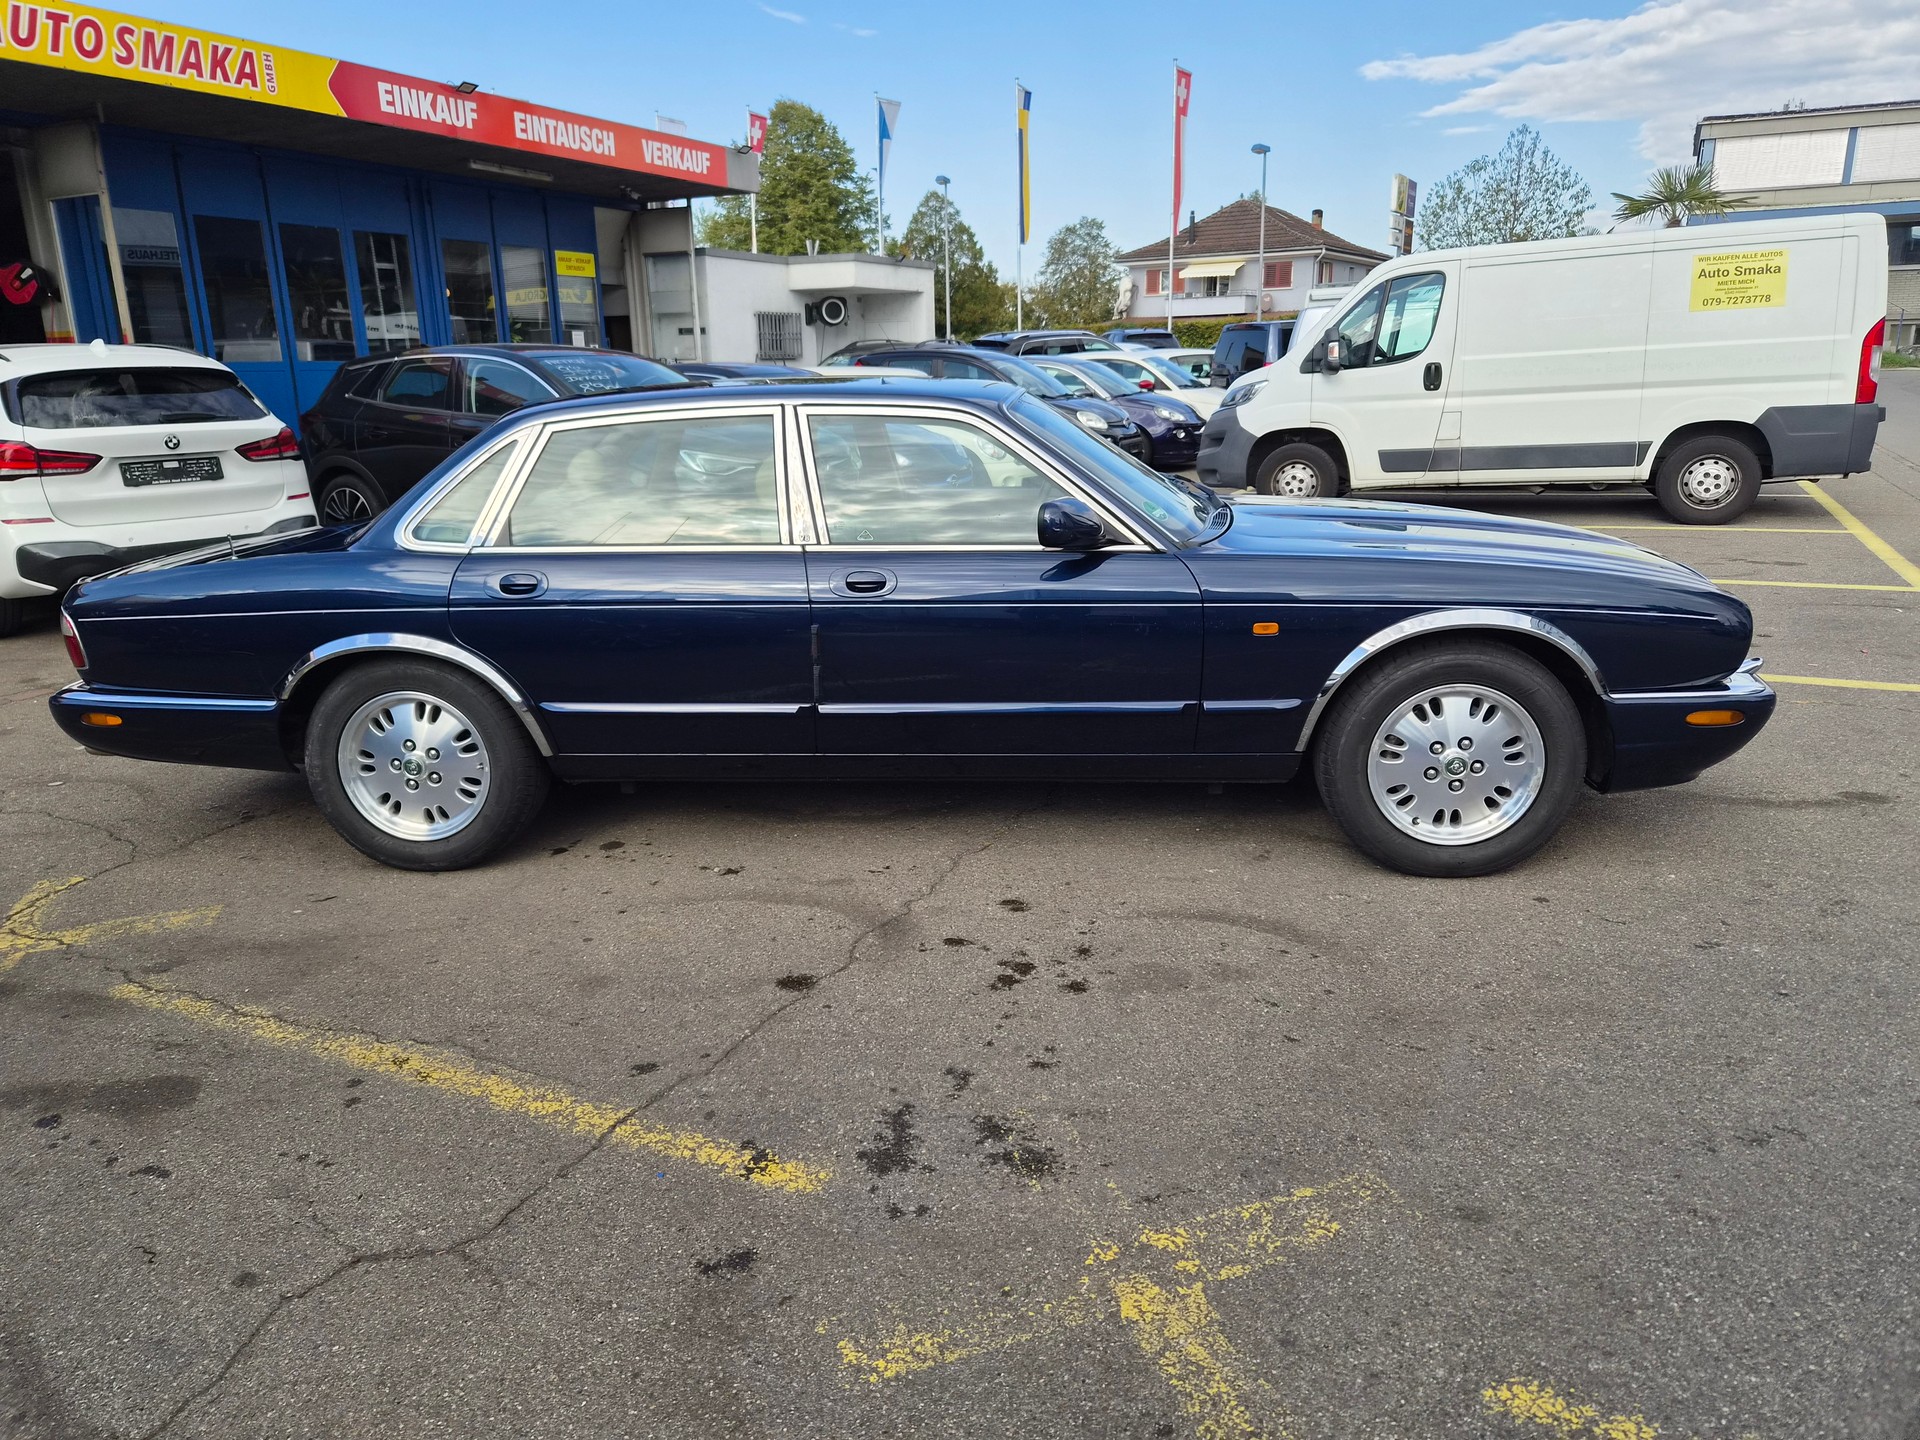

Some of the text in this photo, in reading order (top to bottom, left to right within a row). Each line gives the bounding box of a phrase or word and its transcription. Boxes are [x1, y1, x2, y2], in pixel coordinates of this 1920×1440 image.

[0, 3, 260, 90] UTO SMAKA
[264, 52, 277, 94] GMBH
[377, 81, 711, 174] EINKAUF EINTAUSCH VERKAUF
[1760, 250, 1783, 258] AUTOS
[1698, 263, 1782, 279] Auto Smaka
[1702, 294, 1771, 306] 079-7273778
